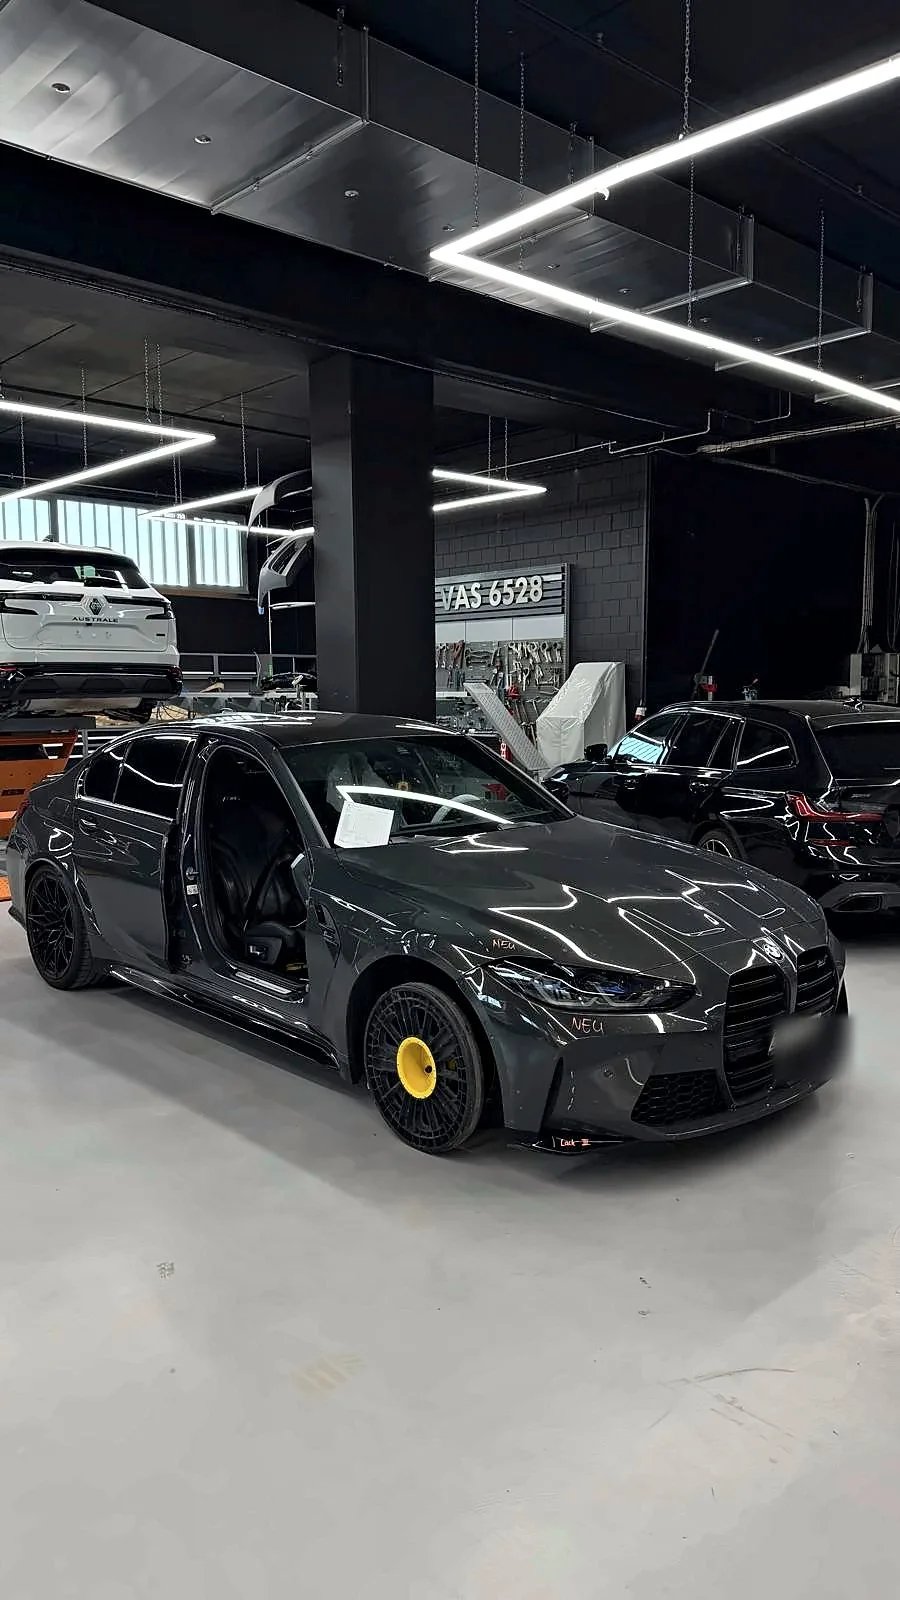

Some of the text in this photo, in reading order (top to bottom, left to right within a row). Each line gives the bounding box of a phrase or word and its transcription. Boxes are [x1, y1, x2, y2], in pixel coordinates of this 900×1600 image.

[441, 575, 544, 611] VAS 6528
[571, 1017, 604, 1033] NEU
